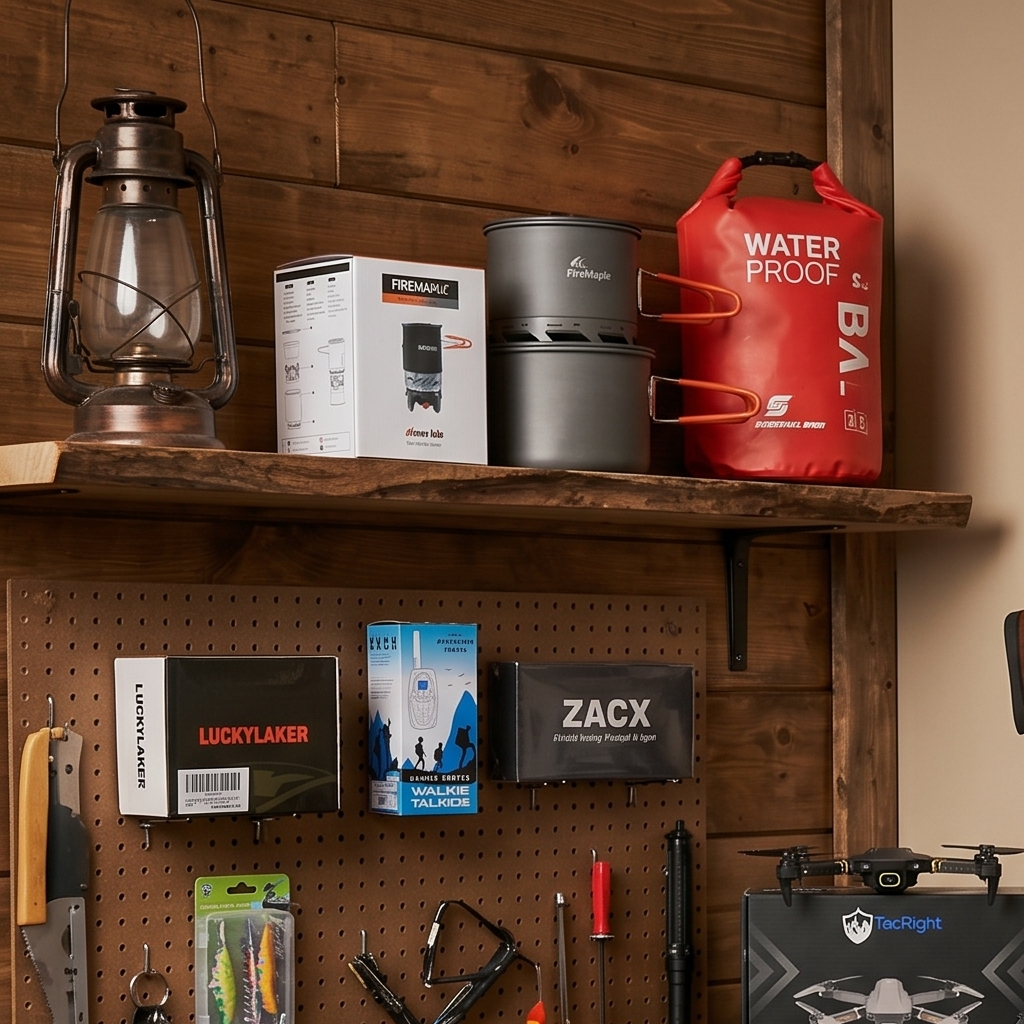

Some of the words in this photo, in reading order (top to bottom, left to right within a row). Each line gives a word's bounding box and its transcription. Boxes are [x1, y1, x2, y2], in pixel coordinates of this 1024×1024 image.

[744, 233, 841, 260] WATER
[746, 260, 840, 286] PROOF
[562, 699, 651, 728] ZACX
[135, 683, 146, 789] LUCKYLAKER
[199, 725, 309, 745] LUCKYLAKER
[411, 785, 470, 796] WALKIE
